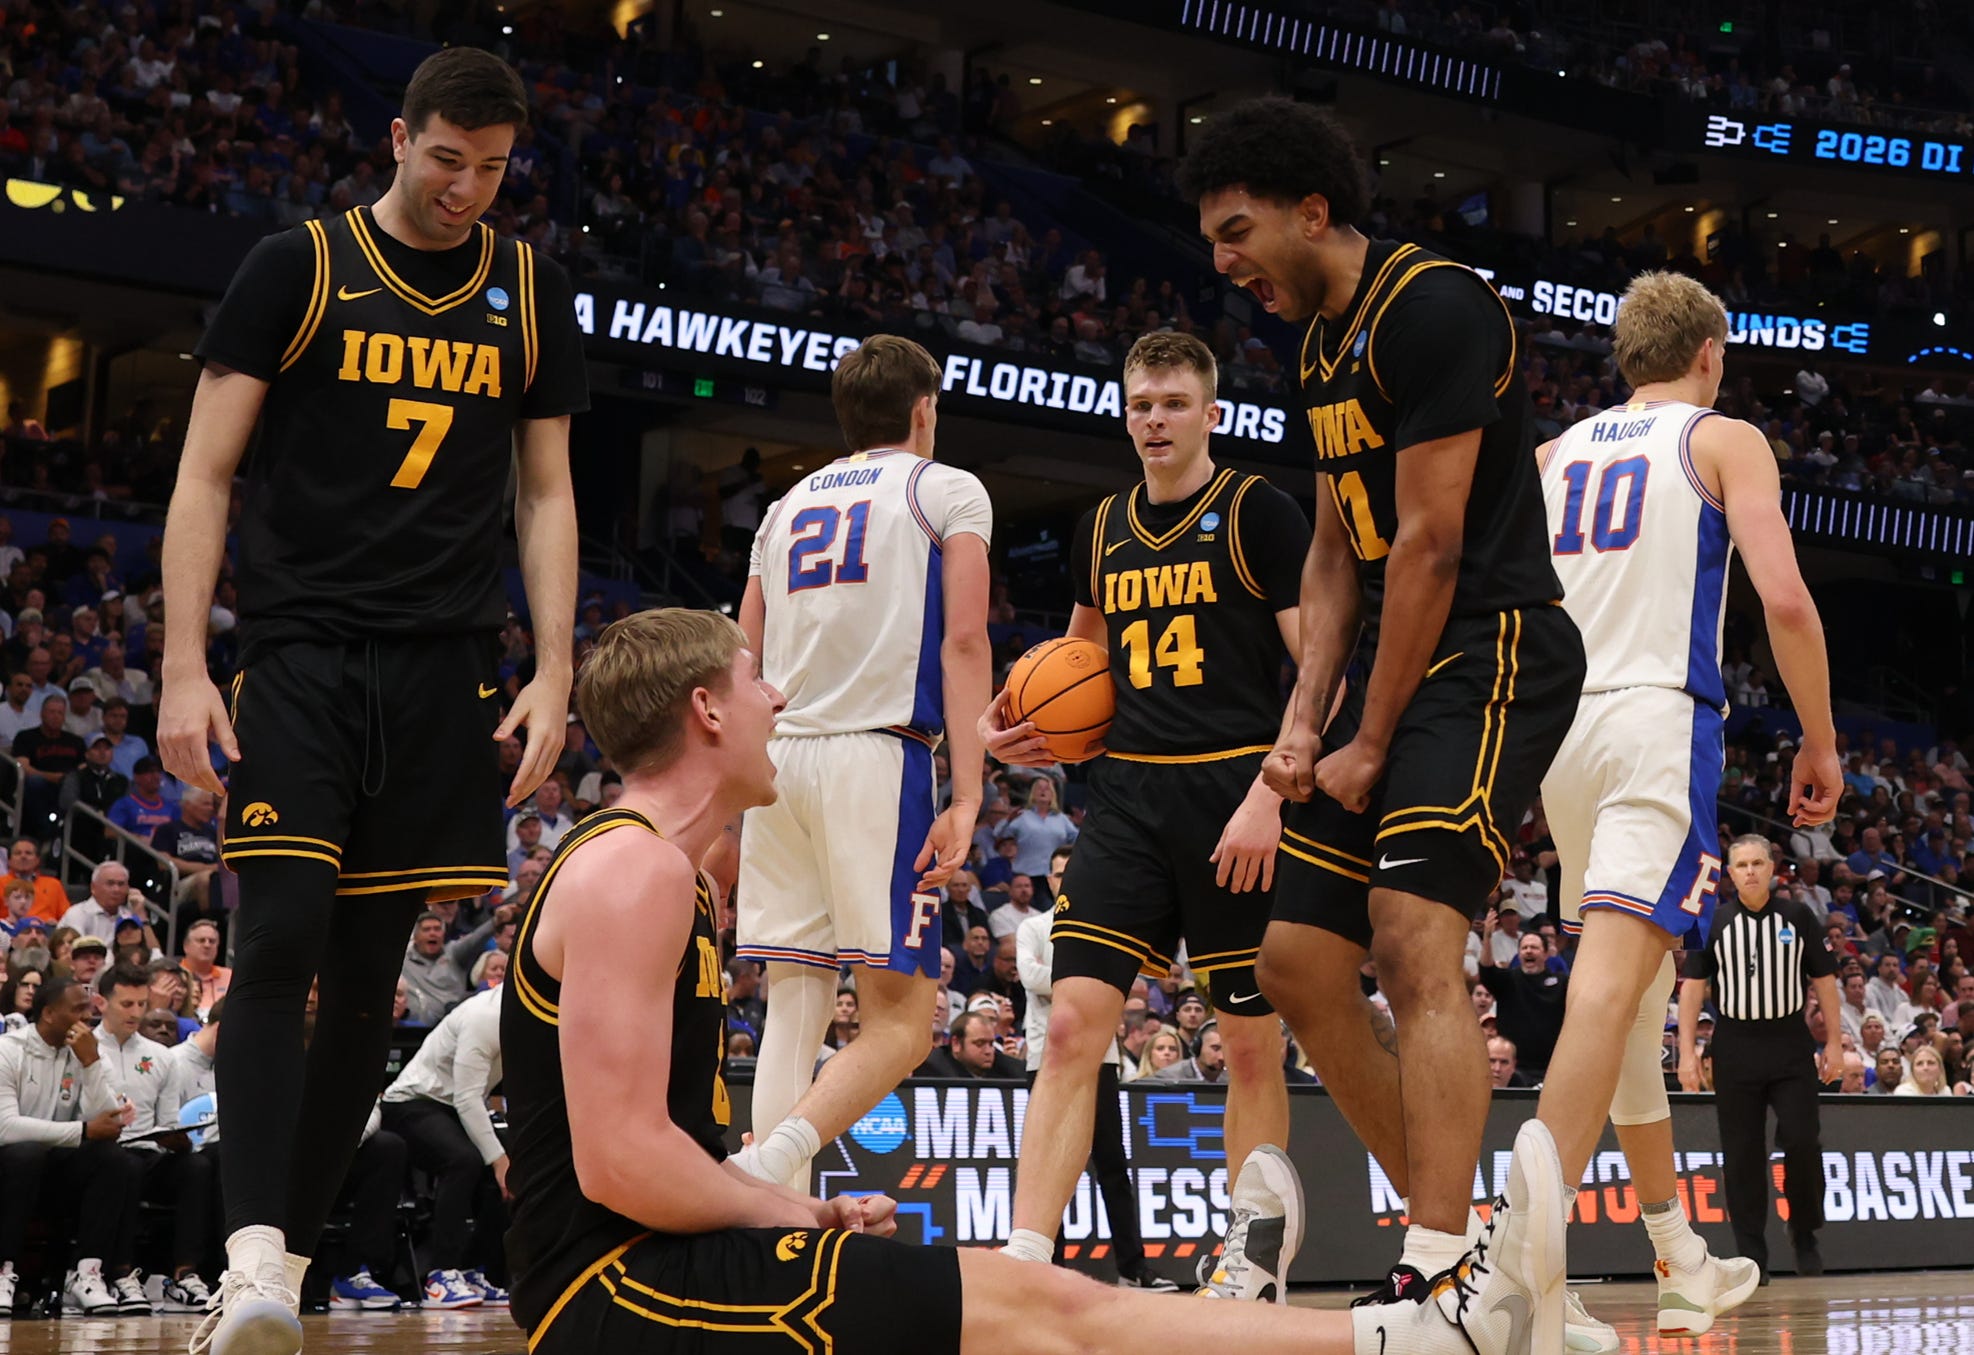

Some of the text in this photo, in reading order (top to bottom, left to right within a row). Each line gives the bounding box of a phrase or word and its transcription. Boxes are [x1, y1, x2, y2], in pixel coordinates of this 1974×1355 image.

[1815, 130, 1964, 173] 2026 DI
[1499, 280, 1826, 350] AND SECO UNDS
[338, 329, 502, 398] IOWA
[642, 371, 663, 390] 101
[942, 354, 1122, 418] FLORIDA
[744, 387, 767, 406] 102
[386, 398, 454, 489] 7
[1591, 417, 1657, 442] HAUGH
[810, 467, 883, 492] CONDON
[1552, 454, 1652, 556] 10
[787, 499, 872, 595] 21
[1104, 561, 1217, 614] IOWA
[1121, 614, 1204, 689] 14
[1679, 851, 1722, 916] F
[903, 891, 941, 949] F
[851, 1117, 908, 1135] NCAA
[1822, 1150, 1974, 1222] BASKE
